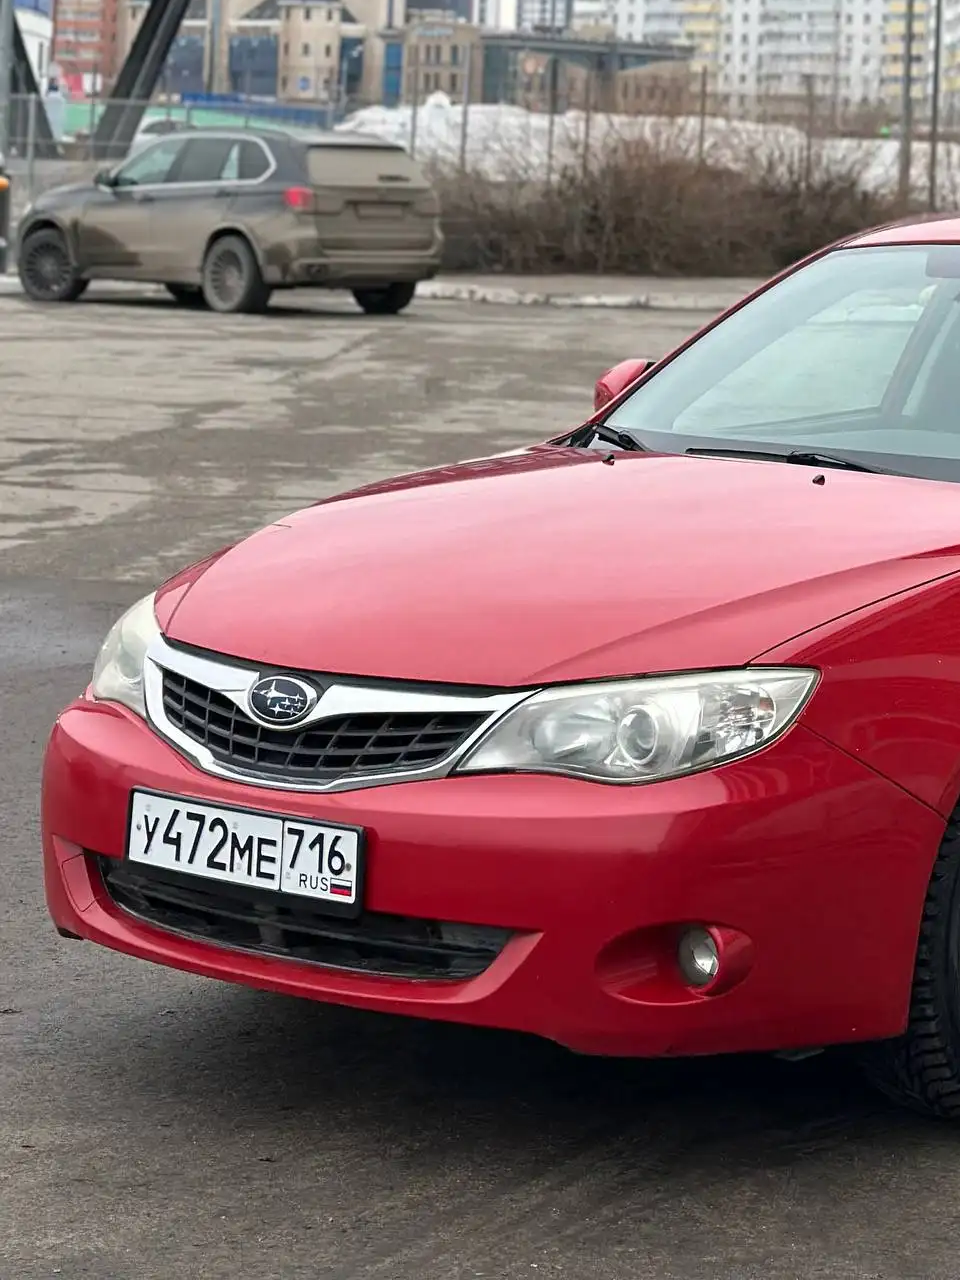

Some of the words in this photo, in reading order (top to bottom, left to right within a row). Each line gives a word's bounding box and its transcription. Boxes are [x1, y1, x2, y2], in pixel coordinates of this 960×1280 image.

[143, 808, 277, 881] У472МЕ
[287, 827, 346, 876] 716
[299, 873, 329, 892] RUS
